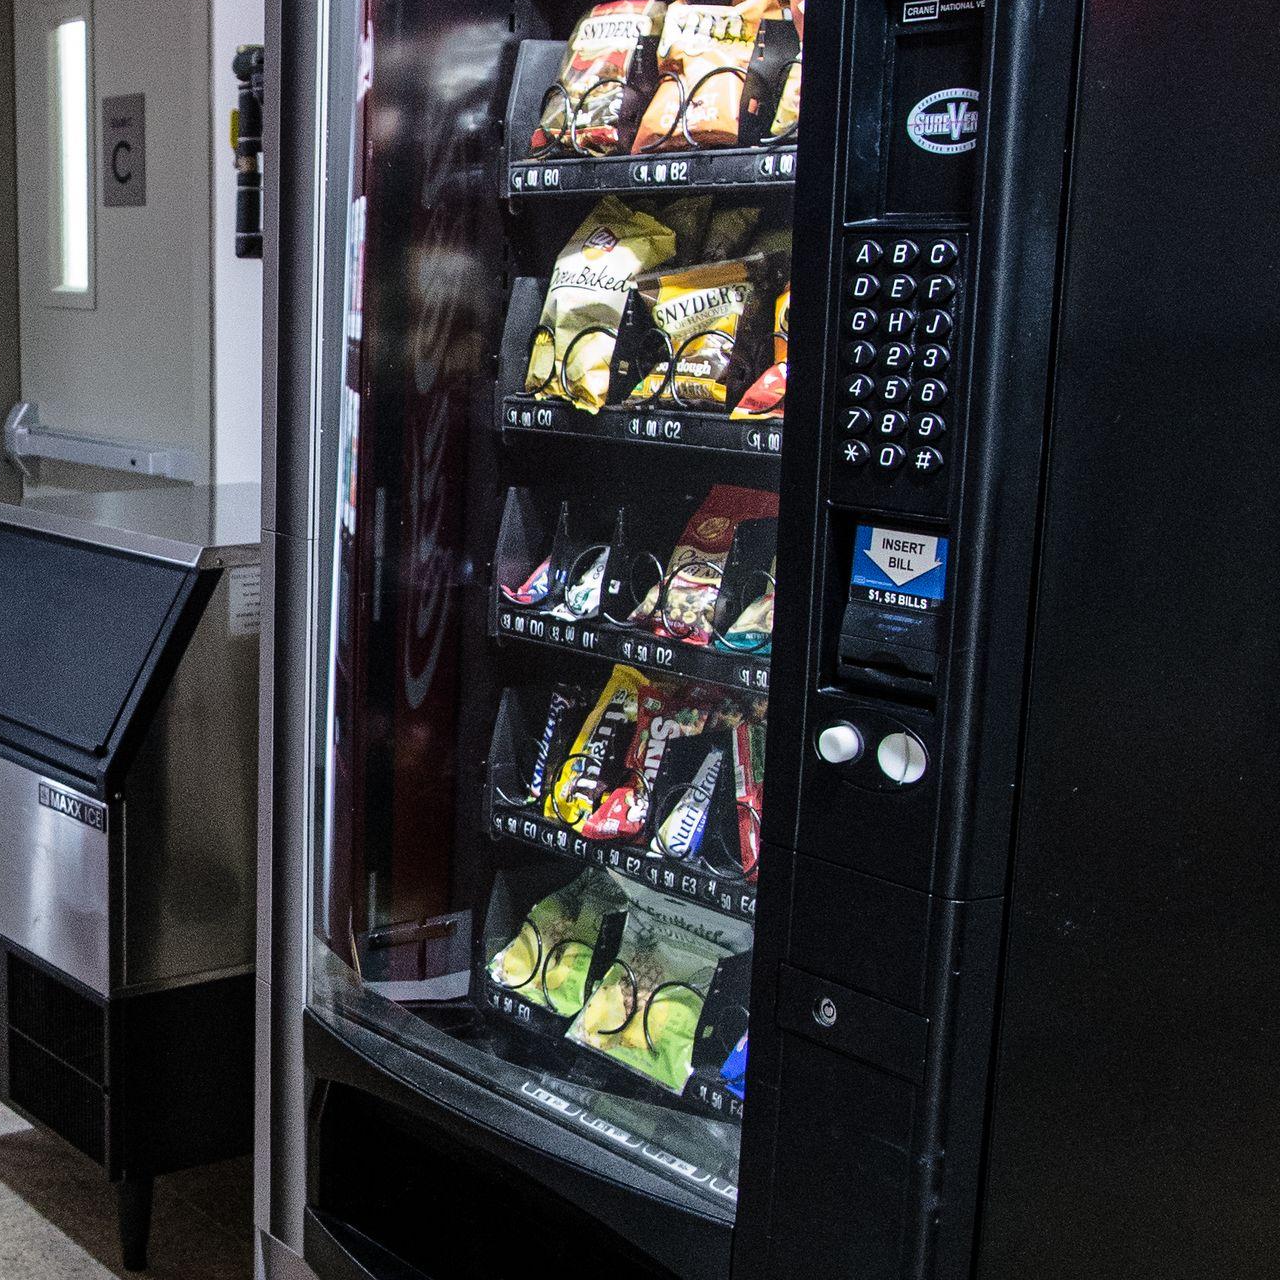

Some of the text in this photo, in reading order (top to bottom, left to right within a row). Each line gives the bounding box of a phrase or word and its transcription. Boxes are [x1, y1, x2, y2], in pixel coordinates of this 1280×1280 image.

[907, 5, 935, 16] CRANE
[940, 1, 975, 12] NATIONAL
[111, 140, 132, 184] C
[670, 162, 687, 181] B2
[544, 169, 559, 186] B0
[856, 244, 944, 263] A B C
[577, 265, 632, 292] Baked
[854, 278, 941, 298] D E F
[852, 312, 940, 333] G H J
[854, 346, 937, 367] 1 2 3
[849, 379, 935, 401] 4 5 6
[537, 409, 552, 426] C0
[847, 411, 933, 435] 7 8 9
[664, 420, 681, 440] C2
[880, 447, 893, 466] 0
[915, 451, 931, 469] #
[882, 538, 926, 555] INSERT
[888, 557, 913, 572] BILL
[884, 592, 897, 604] $5
[898, 594, 928, 609] BILLS
[656, 647, 672, 666] D2
[51, 788, 82, 819] MAXX
[84, 805, 103, 830] ICE
[670, 805, 700, 855] Nutri
[524, 821, 537, 839] E0
[574, 839, 587, 858] E1
[627, 857, 640, 875] E2
[682, 876, 697, 895] E3
[740, 895, 756, 915] E4
